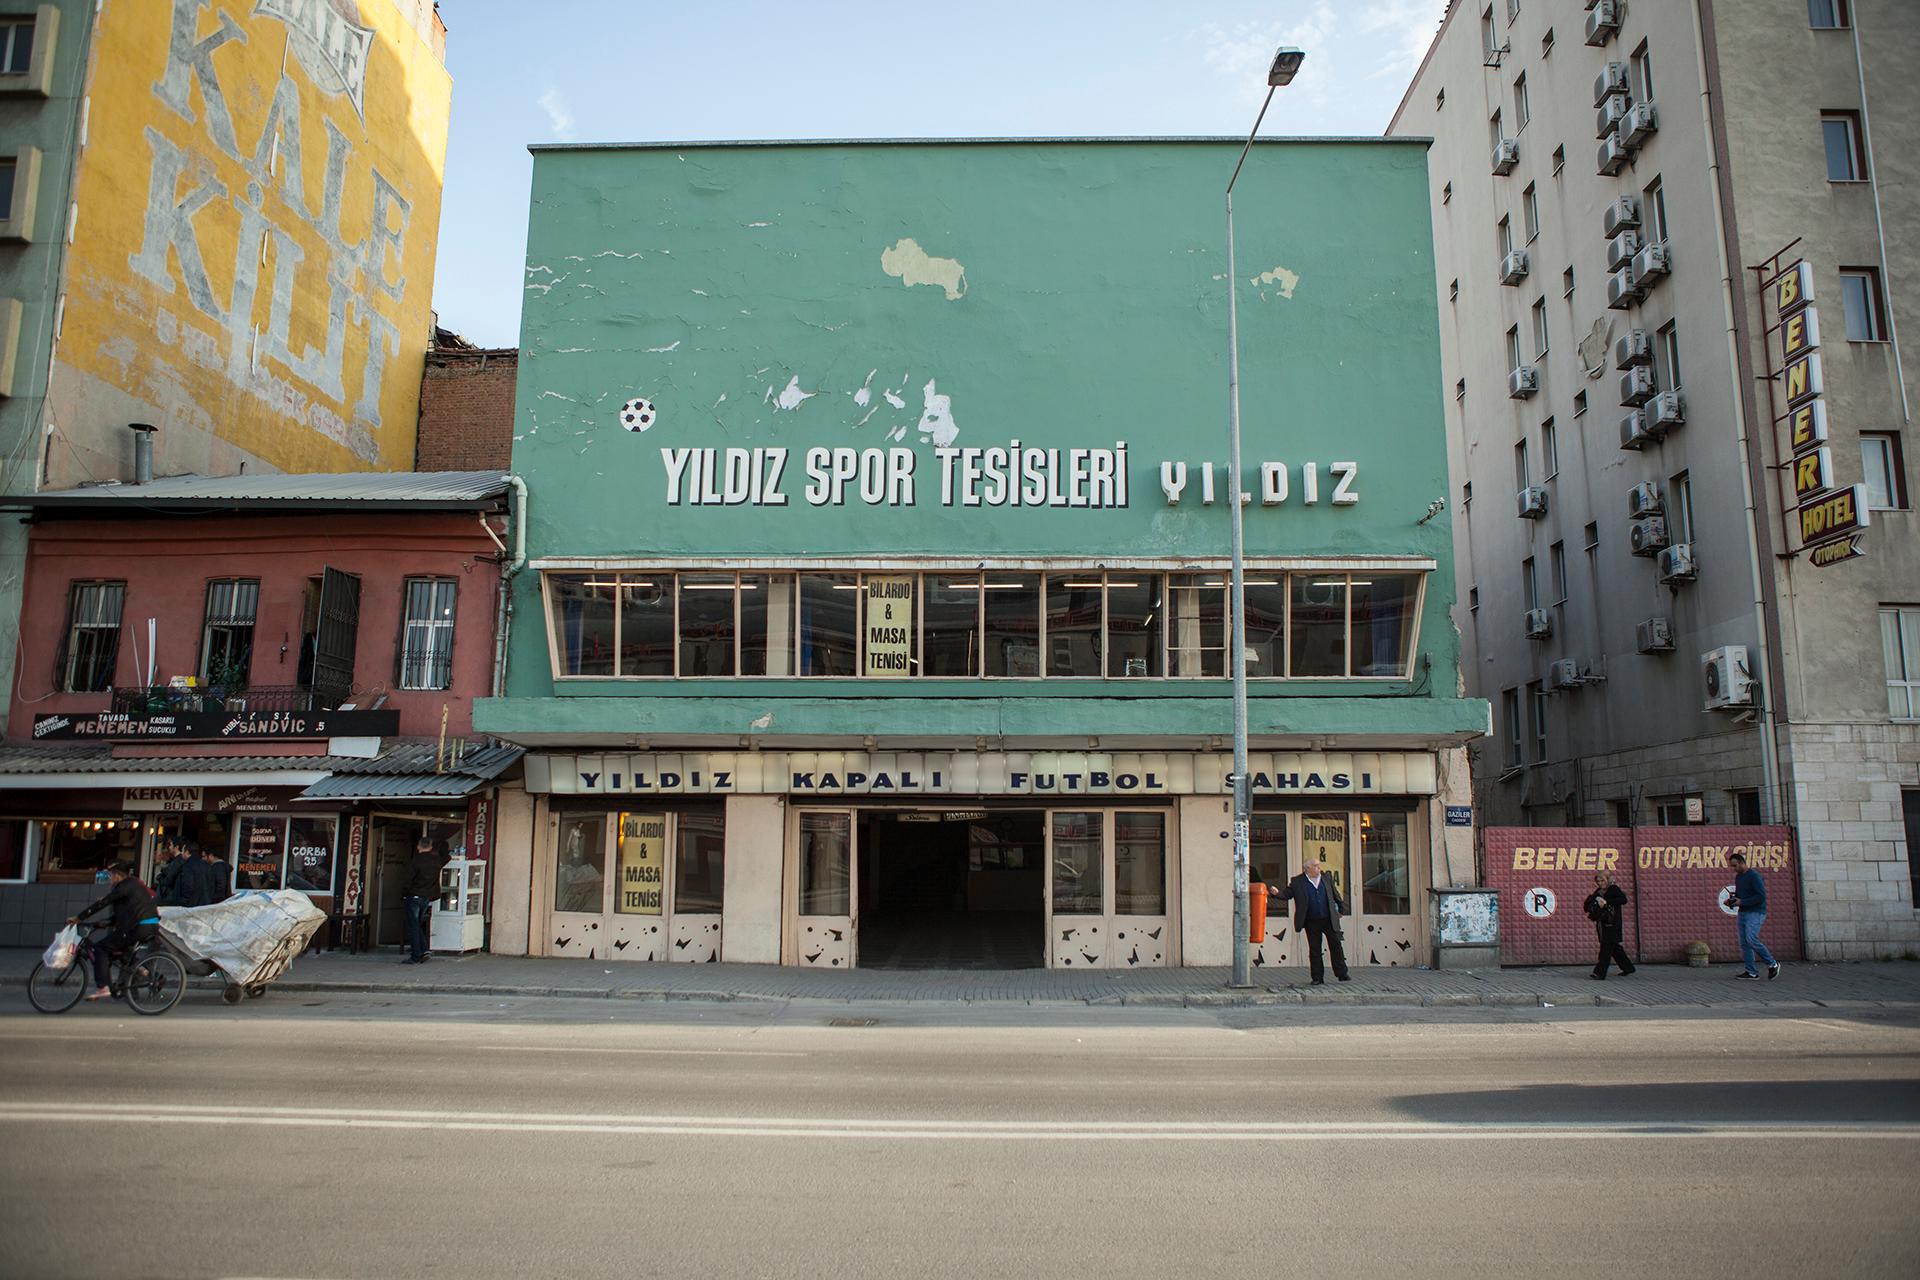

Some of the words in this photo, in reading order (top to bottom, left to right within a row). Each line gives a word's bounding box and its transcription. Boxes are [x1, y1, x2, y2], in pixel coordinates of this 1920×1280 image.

[1777, 270, 1818, 491] BENER
[660, 447, 789, 506] YILDIZ
[805, 447, 916, 506] SPOR
[935, 439, 1129, 508] TESİSLERİ
[1803, 493, 1854, 541] HOTEL
[1815, 539, 1851, 565] OTOPARK
[870, 580, 910, 599] BİLARDO
[885, 603, 892, 620] &
[871, 627, 907, 644] MASA
[870, 651, 907, 669] TENİSİ
[74, 721, 148, 734] MENEMEN
[580, 772, 732, 788] YILDIZ
[793, 772, 942, 789] KAPALI
[1010, 771, 1163, 789] FUTBOL
[126, 787, 198, 800] KERVAN
[164, 801, 195, 810] BÜFE
[625, 819, 664, 839] BİLARDO
[1304, 822, 1343, 842] BİLARDO
[292, 846, 327, 857] ÇORBA
[640, 843, 648, 859] &
[1320, 846, 1327, 862] &
[1512, 847, 1620, 871] BENER
[1638, 846, 1729, 869] OTOPARK
[239, 863, 277, 872] MENEMEN
[625, 866, 660, 882] MASA
[625, 889, 661, 908] TENİSİ
